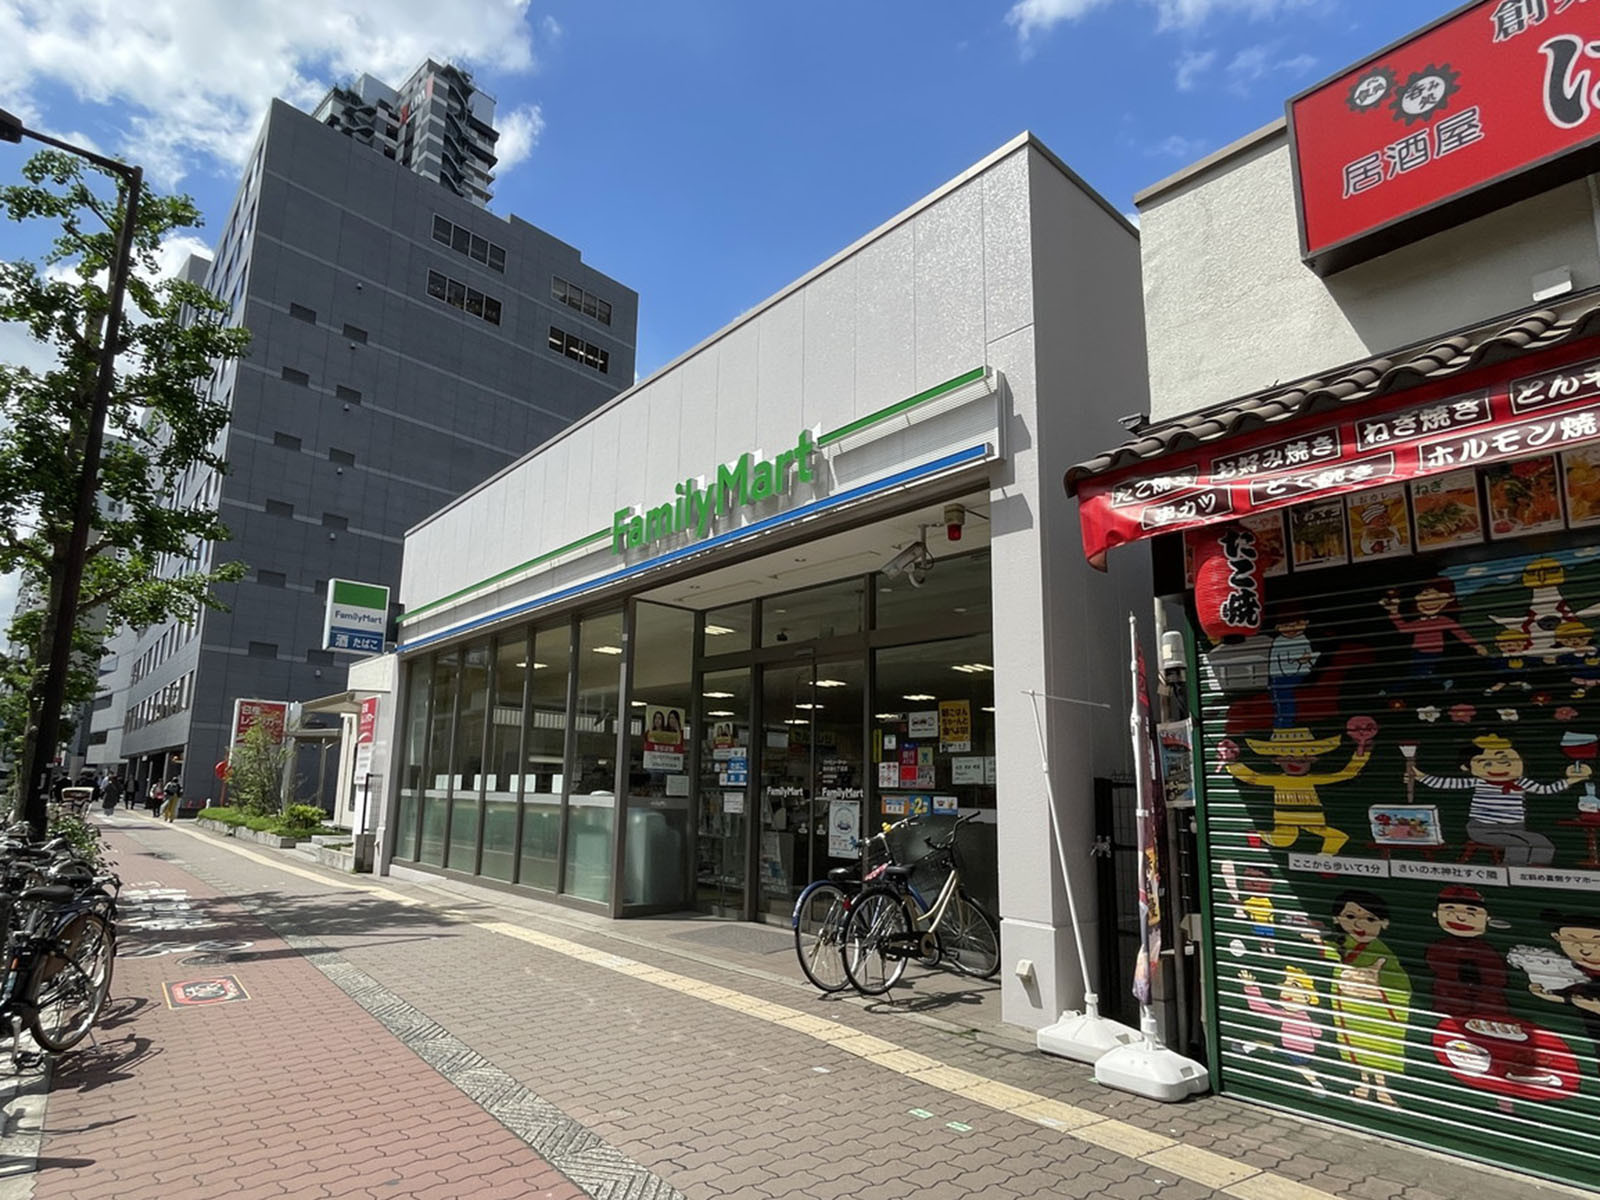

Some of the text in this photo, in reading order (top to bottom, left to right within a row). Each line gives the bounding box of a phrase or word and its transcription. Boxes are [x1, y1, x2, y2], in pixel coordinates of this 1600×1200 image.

[1342, 106, 1485, 199] 居酒屋
[1363, 399, 1480, 444] ねぎ焼き
[1427, 412, 1597, 468] ホルモン焼
[1217, 435, 1334, 479] お好み焼き
[612, 429, 814, 555] FamilyMart
[1114, 475, 1193, 503] たこ焼き
[1155, 492, 1217, 523] 串カツ
[1217, 530, 1262, 629] たこ焼
[335, 610, 382, 624] FamilyMart
[335, 634, 378, 650] 酒 たばこ
[767, 786, 804, 798] FamilyMart
[821, 787, 864, 799] FamilyMart
[1292, 859, 1381, 874] ここから歩いて1分
[1398, 864, 1498, 879] さいの木神社すぐ隣
